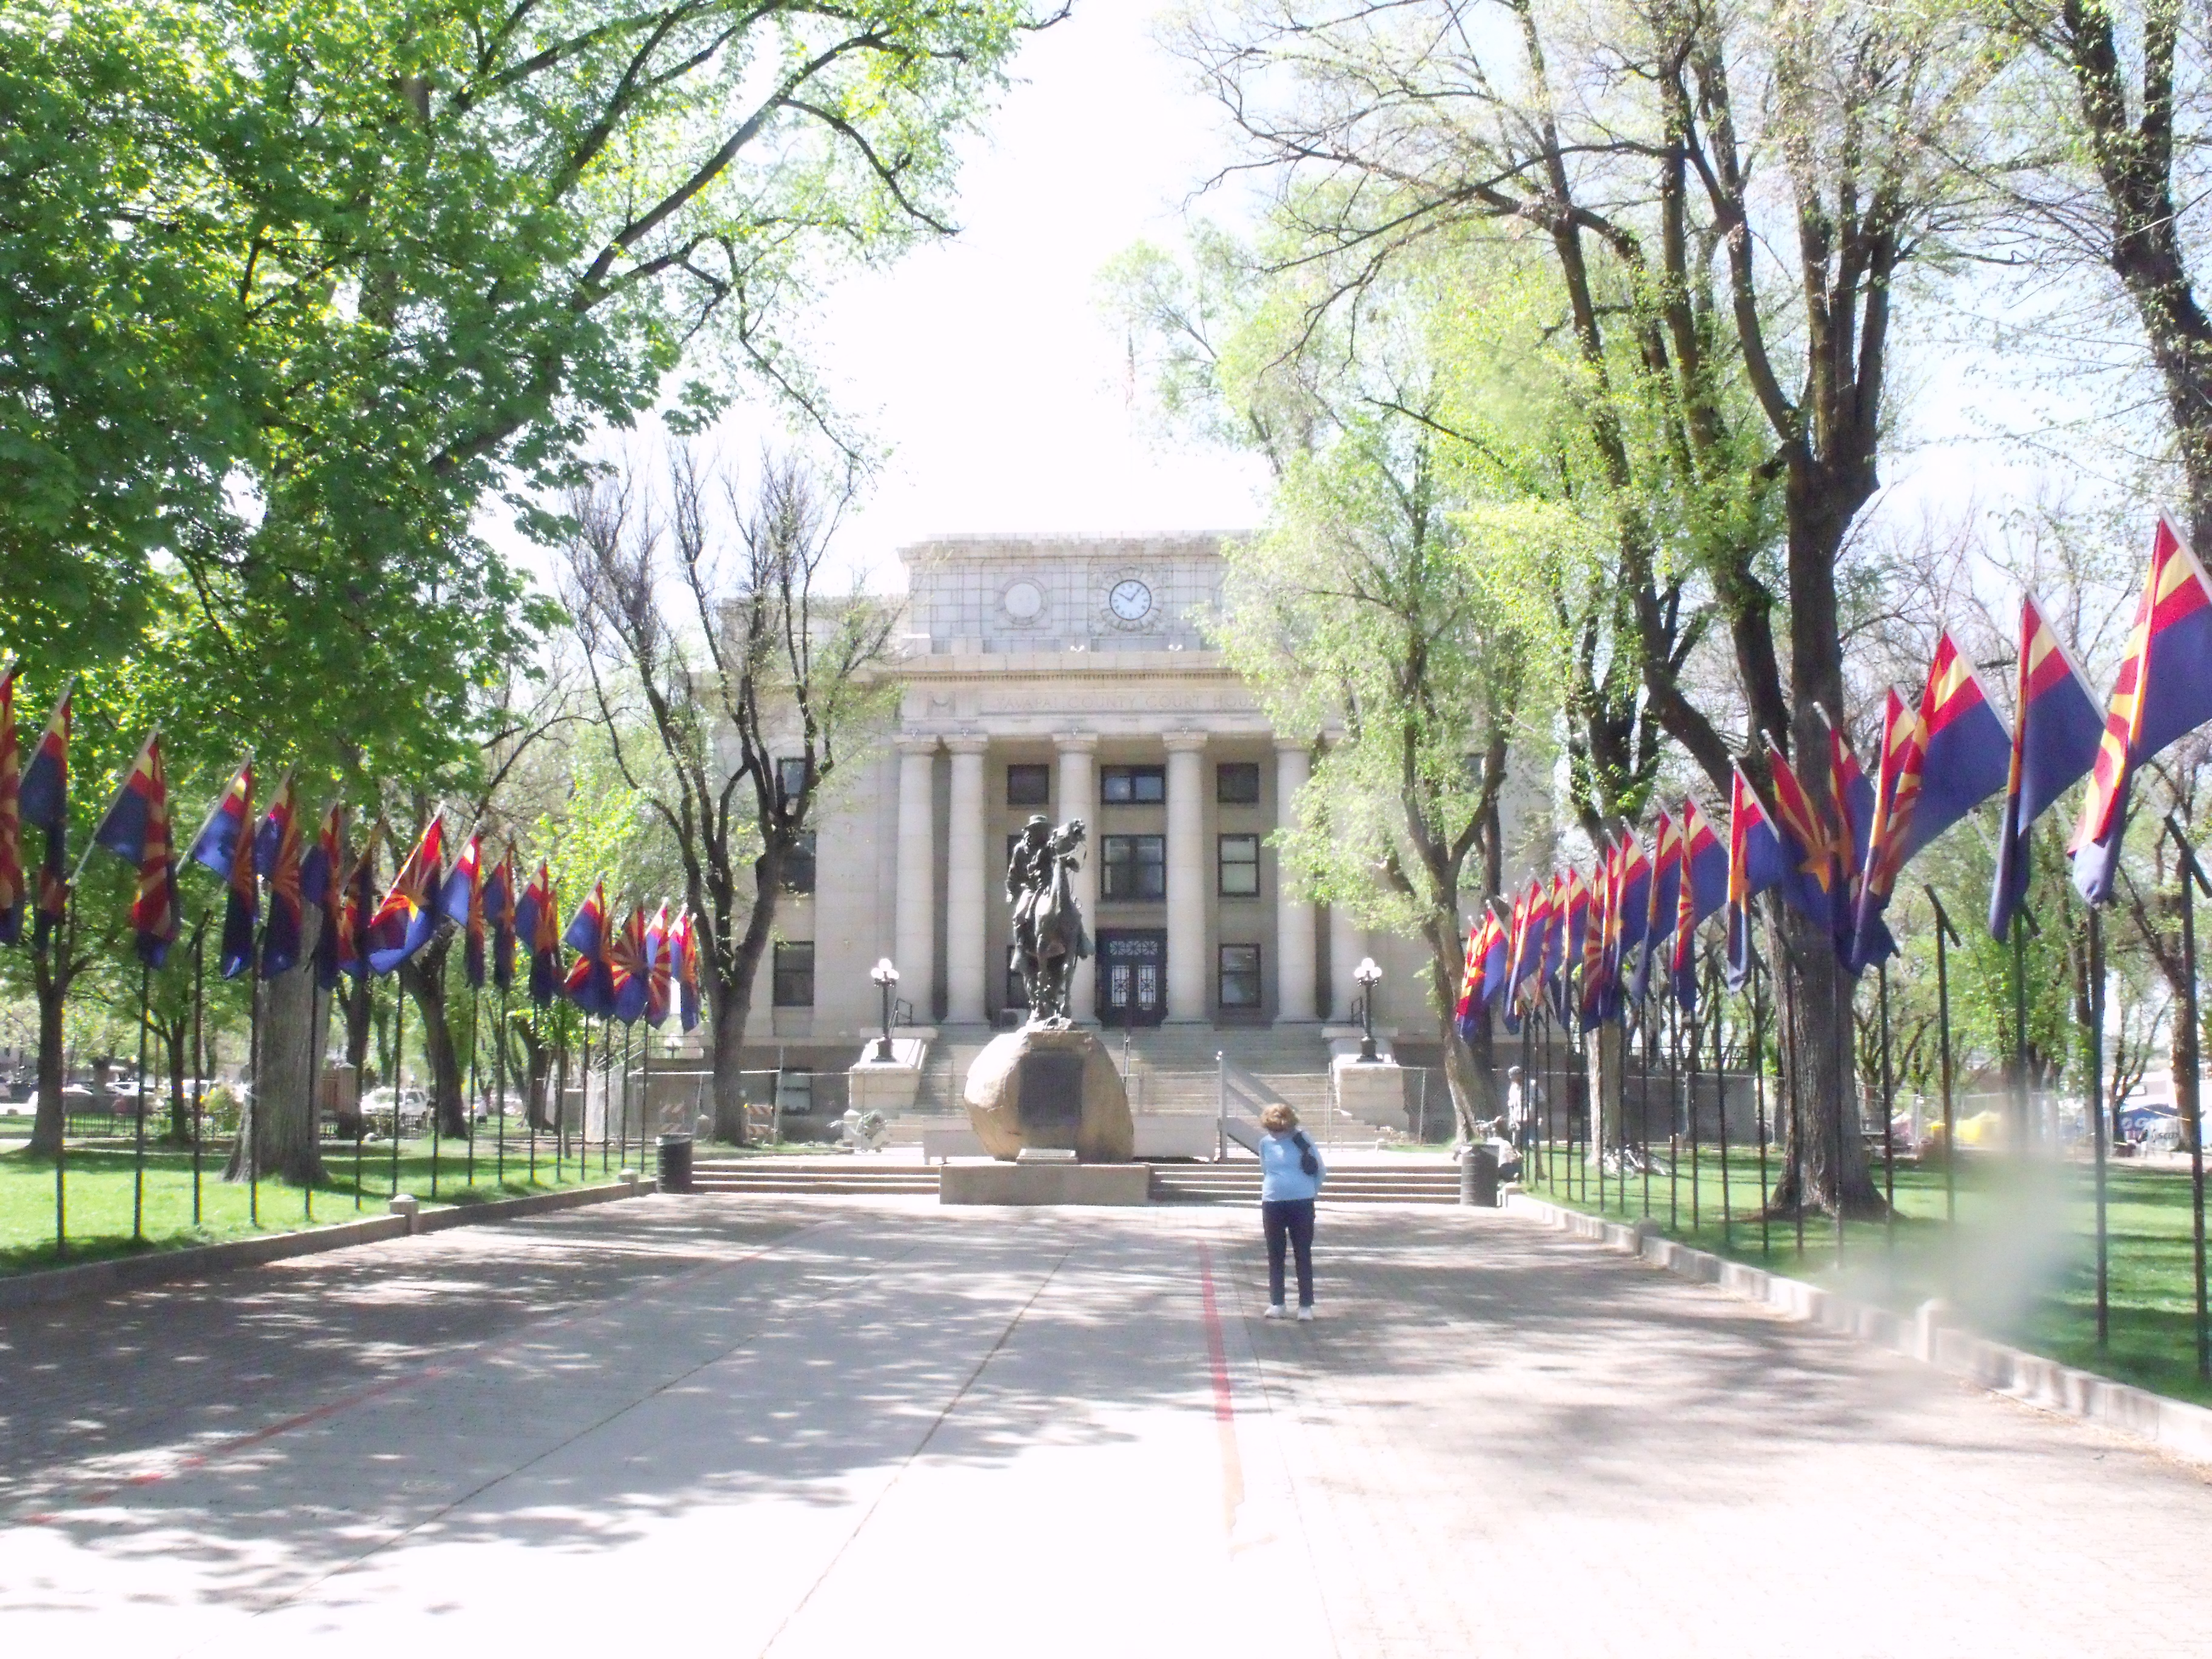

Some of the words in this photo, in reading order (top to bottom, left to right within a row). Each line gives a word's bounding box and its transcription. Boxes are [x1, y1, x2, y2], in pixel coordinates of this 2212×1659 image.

[997, 695, 1057, 708] YAVAPAI
[1068, 695, 1136, 708] COUNTY
[1145, 695, 1199, 707] COURT
